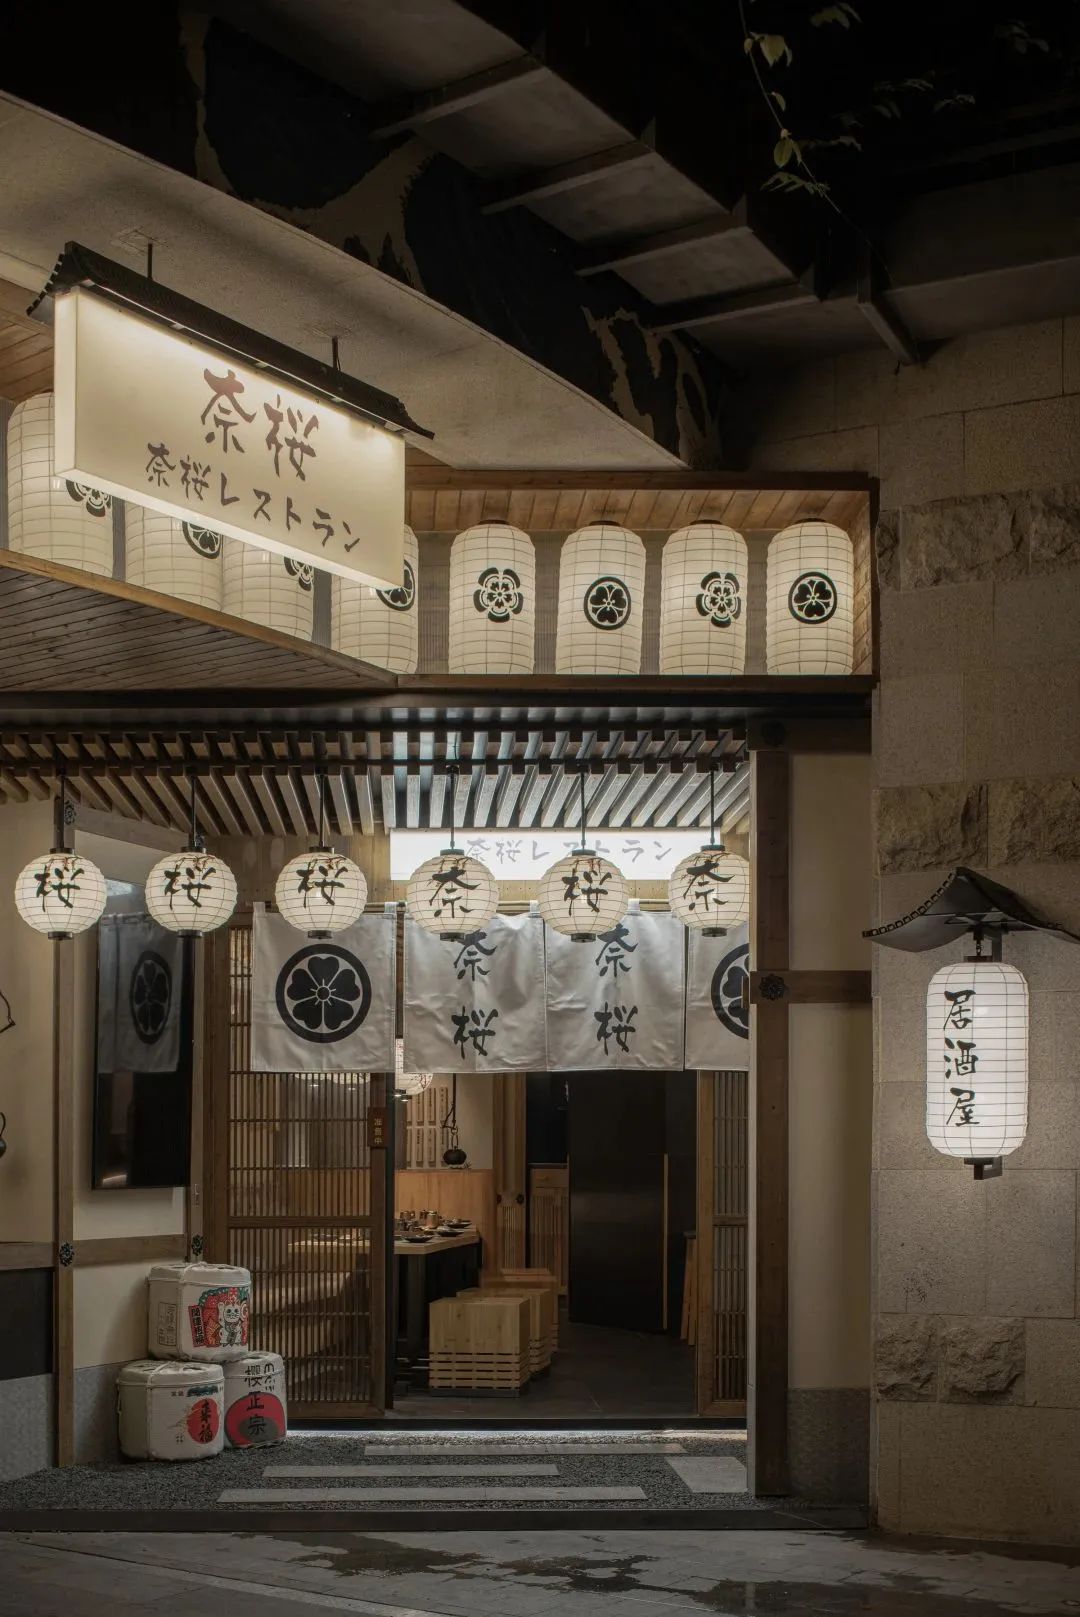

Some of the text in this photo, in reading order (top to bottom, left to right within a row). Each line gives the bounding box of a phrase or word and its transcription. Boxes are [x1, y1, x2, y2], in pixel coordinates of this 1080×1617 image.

[200, 368, 320, 482] 奈桜
[144, 442, 362, 553] 奈桜レストラン
[34, 863, 86, 912] 桜
[164, 862, 217, 910] 桜
[296, 862, 349, 909] 桜
[429, 866, 481, 919] 奈
[562, 867, 612, 916] 桜
[683, 860, 736, 912] 奈
[450, 929, 499, 1060] 奈桜
[594, 923, 639, 1057] 奈桜
[943, 989, 980, 1127] 居酒屋
